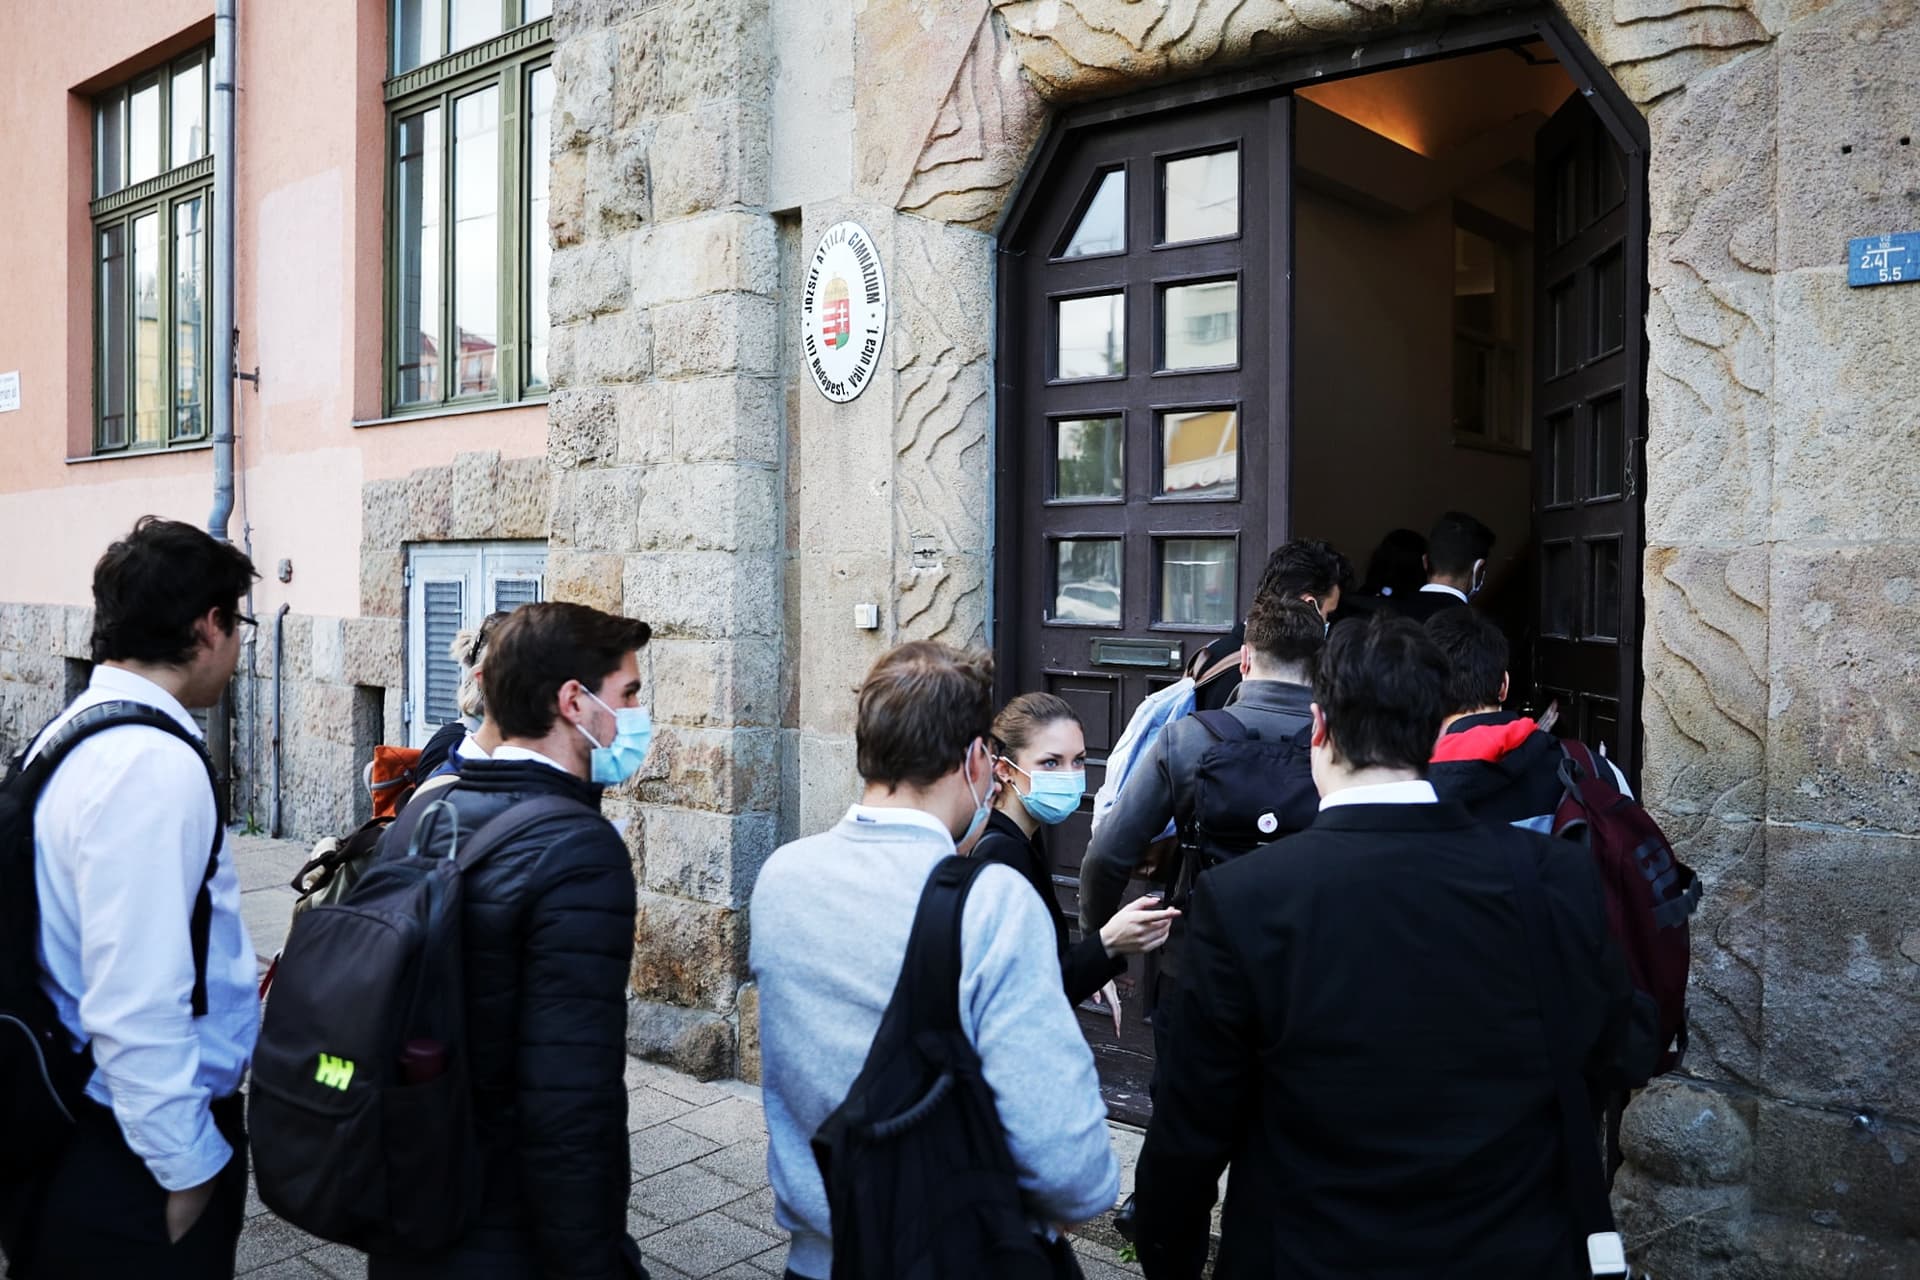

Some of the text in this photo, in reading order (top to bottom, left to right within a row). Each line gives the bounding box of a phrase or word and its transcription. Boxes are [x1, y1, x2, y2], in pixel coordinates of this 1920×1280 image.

[816, 228, 846, 264] ATTILA
[847, 232, 880, 304] GIMNÁZIUM
[847, 366, 867, 388] Váli
[860, 339, 876, 365] utca
